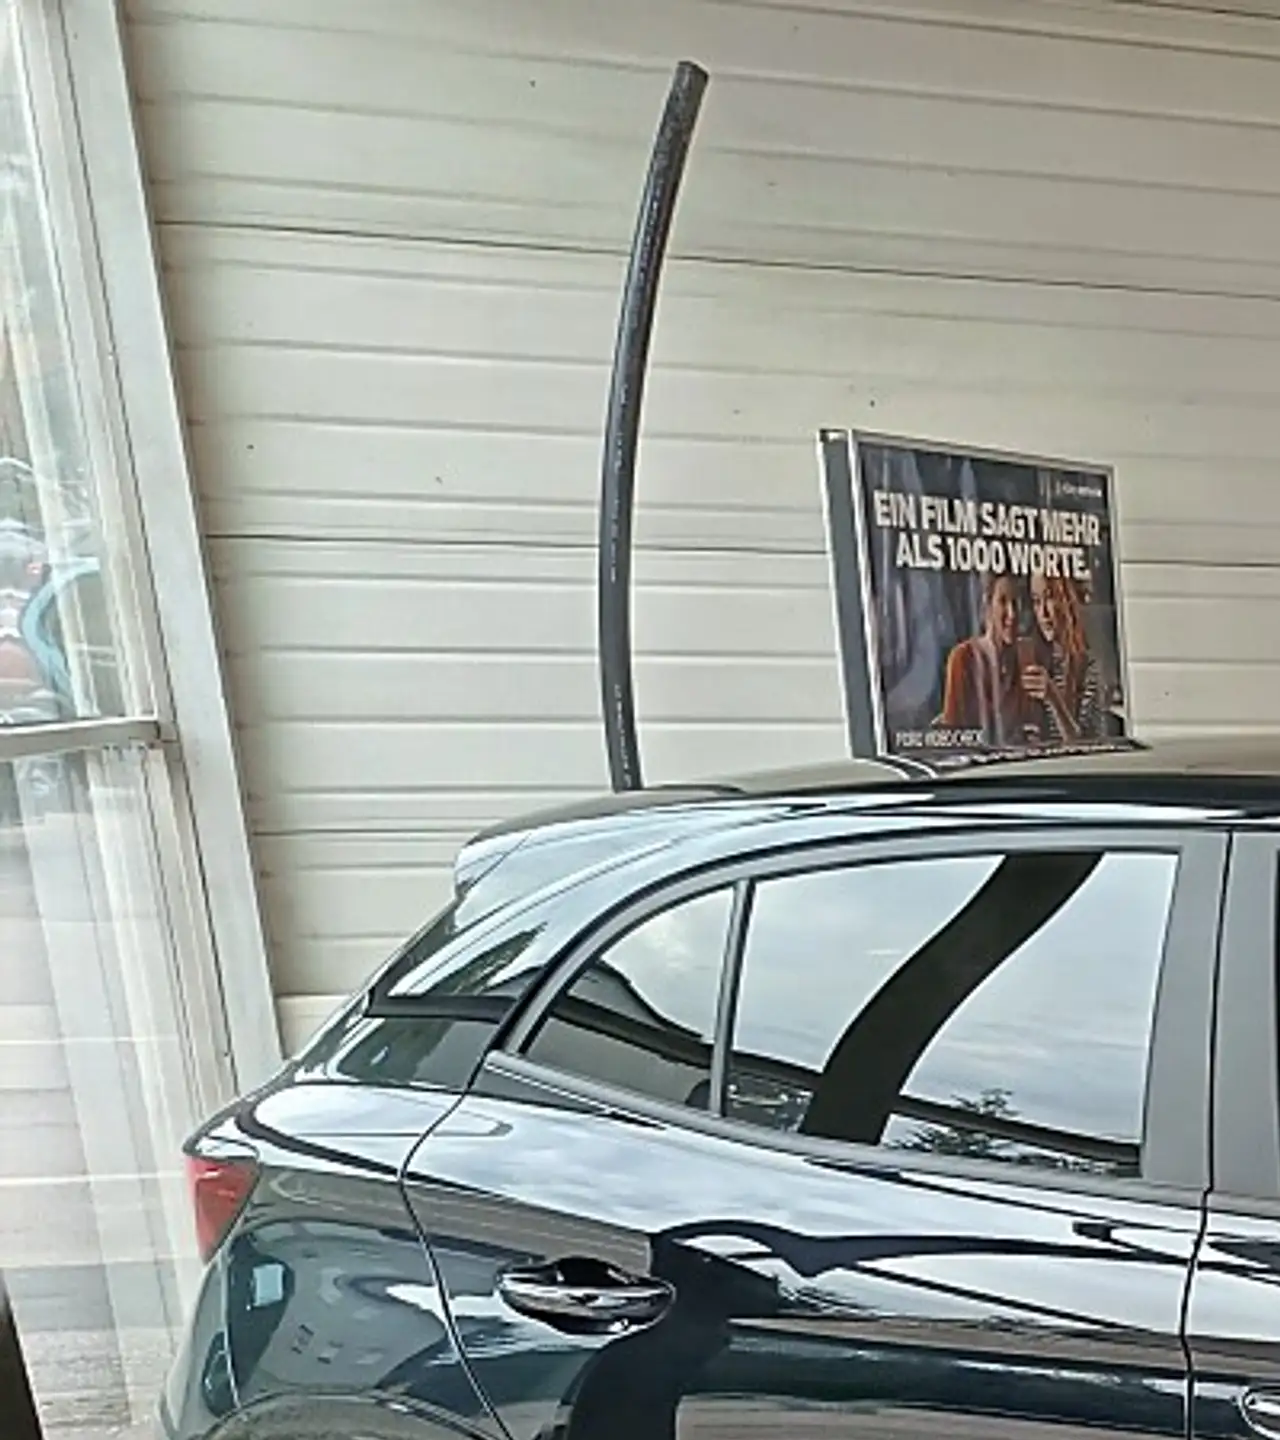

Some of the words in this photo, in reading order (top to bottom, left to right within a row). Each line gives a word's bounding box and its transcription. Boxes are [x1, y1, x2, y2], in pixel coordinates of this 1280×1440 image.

[874, 490, 915, 530] EIN
[921, 496, 977, 534] FILM
[982, 502, 1036, 541] SAGT
[1042, 509, 1101, 546] MEHR
[896, 531, 946, 570] ALS
[948, 538, 1005, 573] 1000
[1008, 542, 1092, 580] WORTE.
